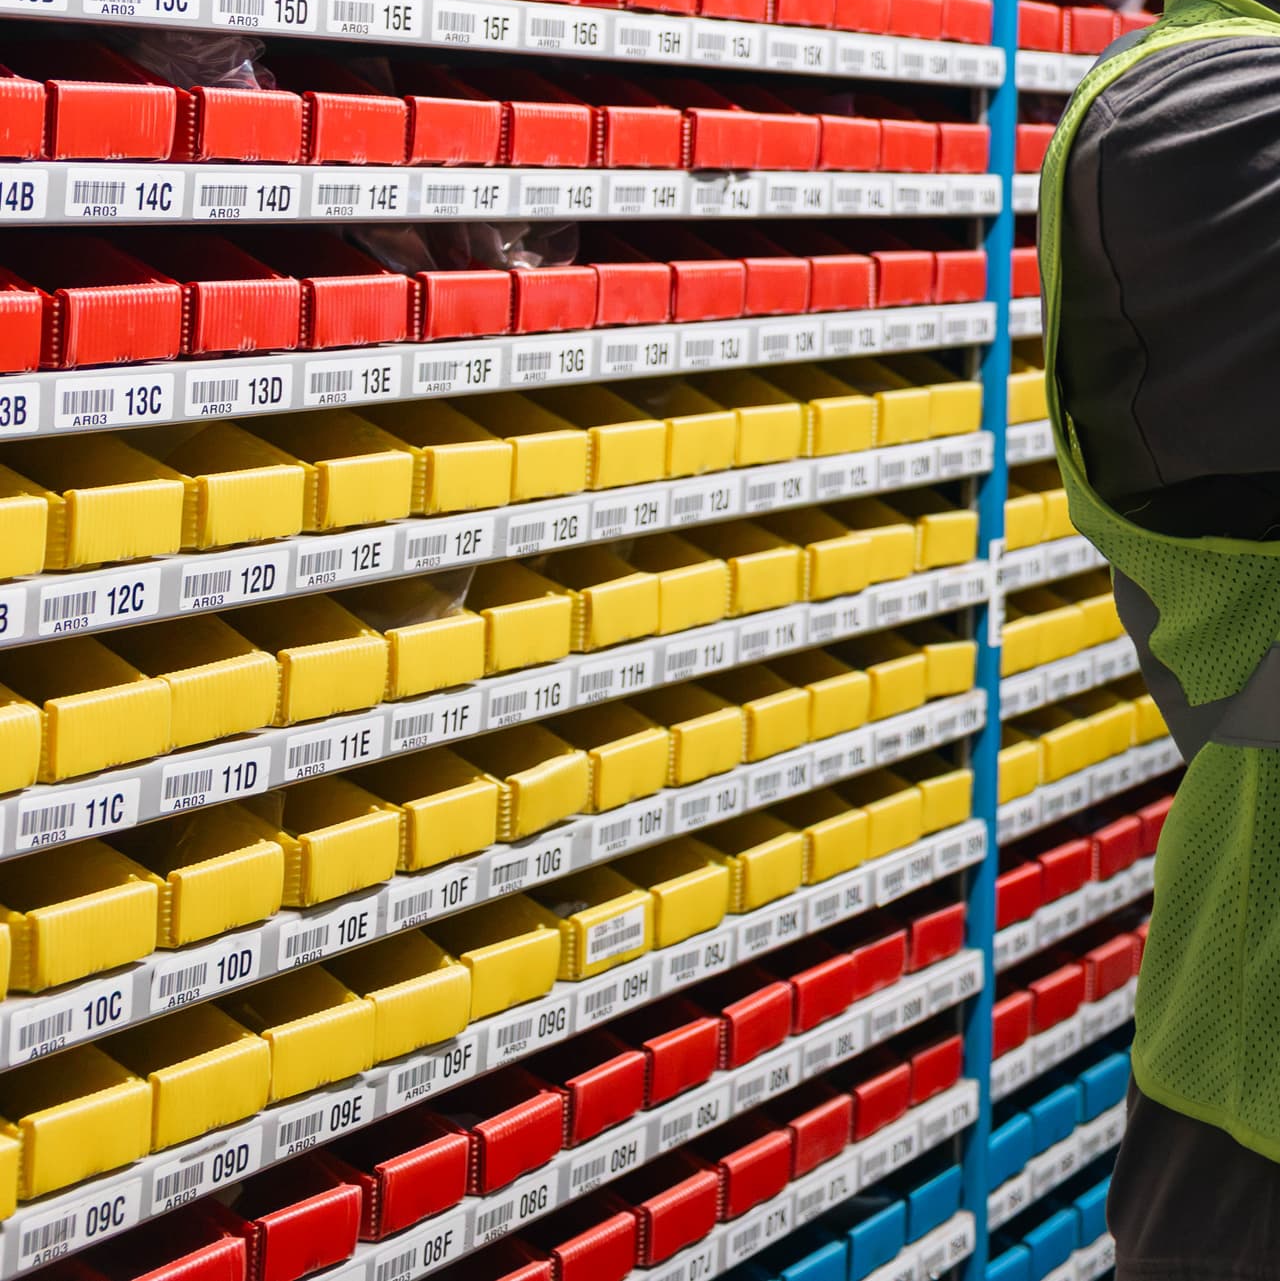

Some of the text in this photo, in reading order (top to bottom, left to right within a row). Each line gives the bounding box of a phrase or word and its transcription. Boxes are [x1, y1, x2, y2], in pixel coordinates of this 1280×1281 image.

[101, 4, 134, 15] AR03
[228, 16, 258, 27] AR03
[384, 6, 411, 30] 15E
[342, 24, 368, 34] AR03
[484, 17, 509, 40] 15F
[573, 23, 597, 45] 15G
[659, 32, 680, 52] 15H
[136, 183, 172, 211] 14C
[257, 186, 290, 211] 14D
[369, 185, 397, 209] 14E
[474, 186, 499, 208] 14F
[568, 186, 591, 208] 14G
[653, 187, 675, 206] 14H
[83, 206, 116, 216] AR03
[209, 208, 239, 218] AR03
[326, 207, 353, 215] AR03
[560, 349, 583, 372] 13G
[646, 344, 667, 365] 13H
[362, 368, 390, 394] 13E
[466, 359, 491, 384] 13F
[126, 386, 161, 415] 13C
[249, 377, 282, 404] 13D
[319, 392, 347, 403] AR03
[73, 414, 106, 426] AR03
[201, 403, 232, 414] AR03
[635, 503, 657, 525] 12H
[553, 516, 577, 541] 12G
[456, 529, 482, 556] 12F
[352, 542, 381, 571] 12E
[242, 564, 275, 594] 12D
[308, 572, 335, 585] AR03
[108, 583, 144, 615] 12C
[192, 594, 224, 608] AR03
[54, 617, 88, 632] AR03
[621, 663, 644, 687] 11H
[533, 683, 561, 711] 11G
[442, 705, 469, 734] 11F
[341, 730, 370, 760] 11E
[223, 762, 257, 793] 11D
[296, 763, 326, 777] AR03
[87, 794, 123, 828] 11C
[174, 795, 204, 809] AR03
[639, 809, 662, 835] 10H
[31, 830, 67, 847] AR03
[536, 848, 561, 876] 10G
[442, 877, 468, 907] 10F
[339, 912, 368, 944] 10E
[218, 950, 252, 984] 10D
[168, 988, 199, 1007] AR03
[623, 971, 648, 1001] 09H
[84, 991, 121, 1029] 10C
[539, 1007, 565, 1037] 09G
[30, 1037, 66, 1059] AR03
[443, 1046, 473, 1077] 09F
[331, 1096, 362, 1131] 09E
[287, 1138, 317, 1154] AR03
[611, 1142, 636, 1172] 08H
[213, 1144, 248, 1182] 09D
[165, 1191, 198, 1210] AR03
[520, 1185, 547, 1218] 08G
[85, 1196, 126, 1236] 09C
[33, 1244, 68, 1266] AR03
[424, 1230, 453, 1266] 08F
